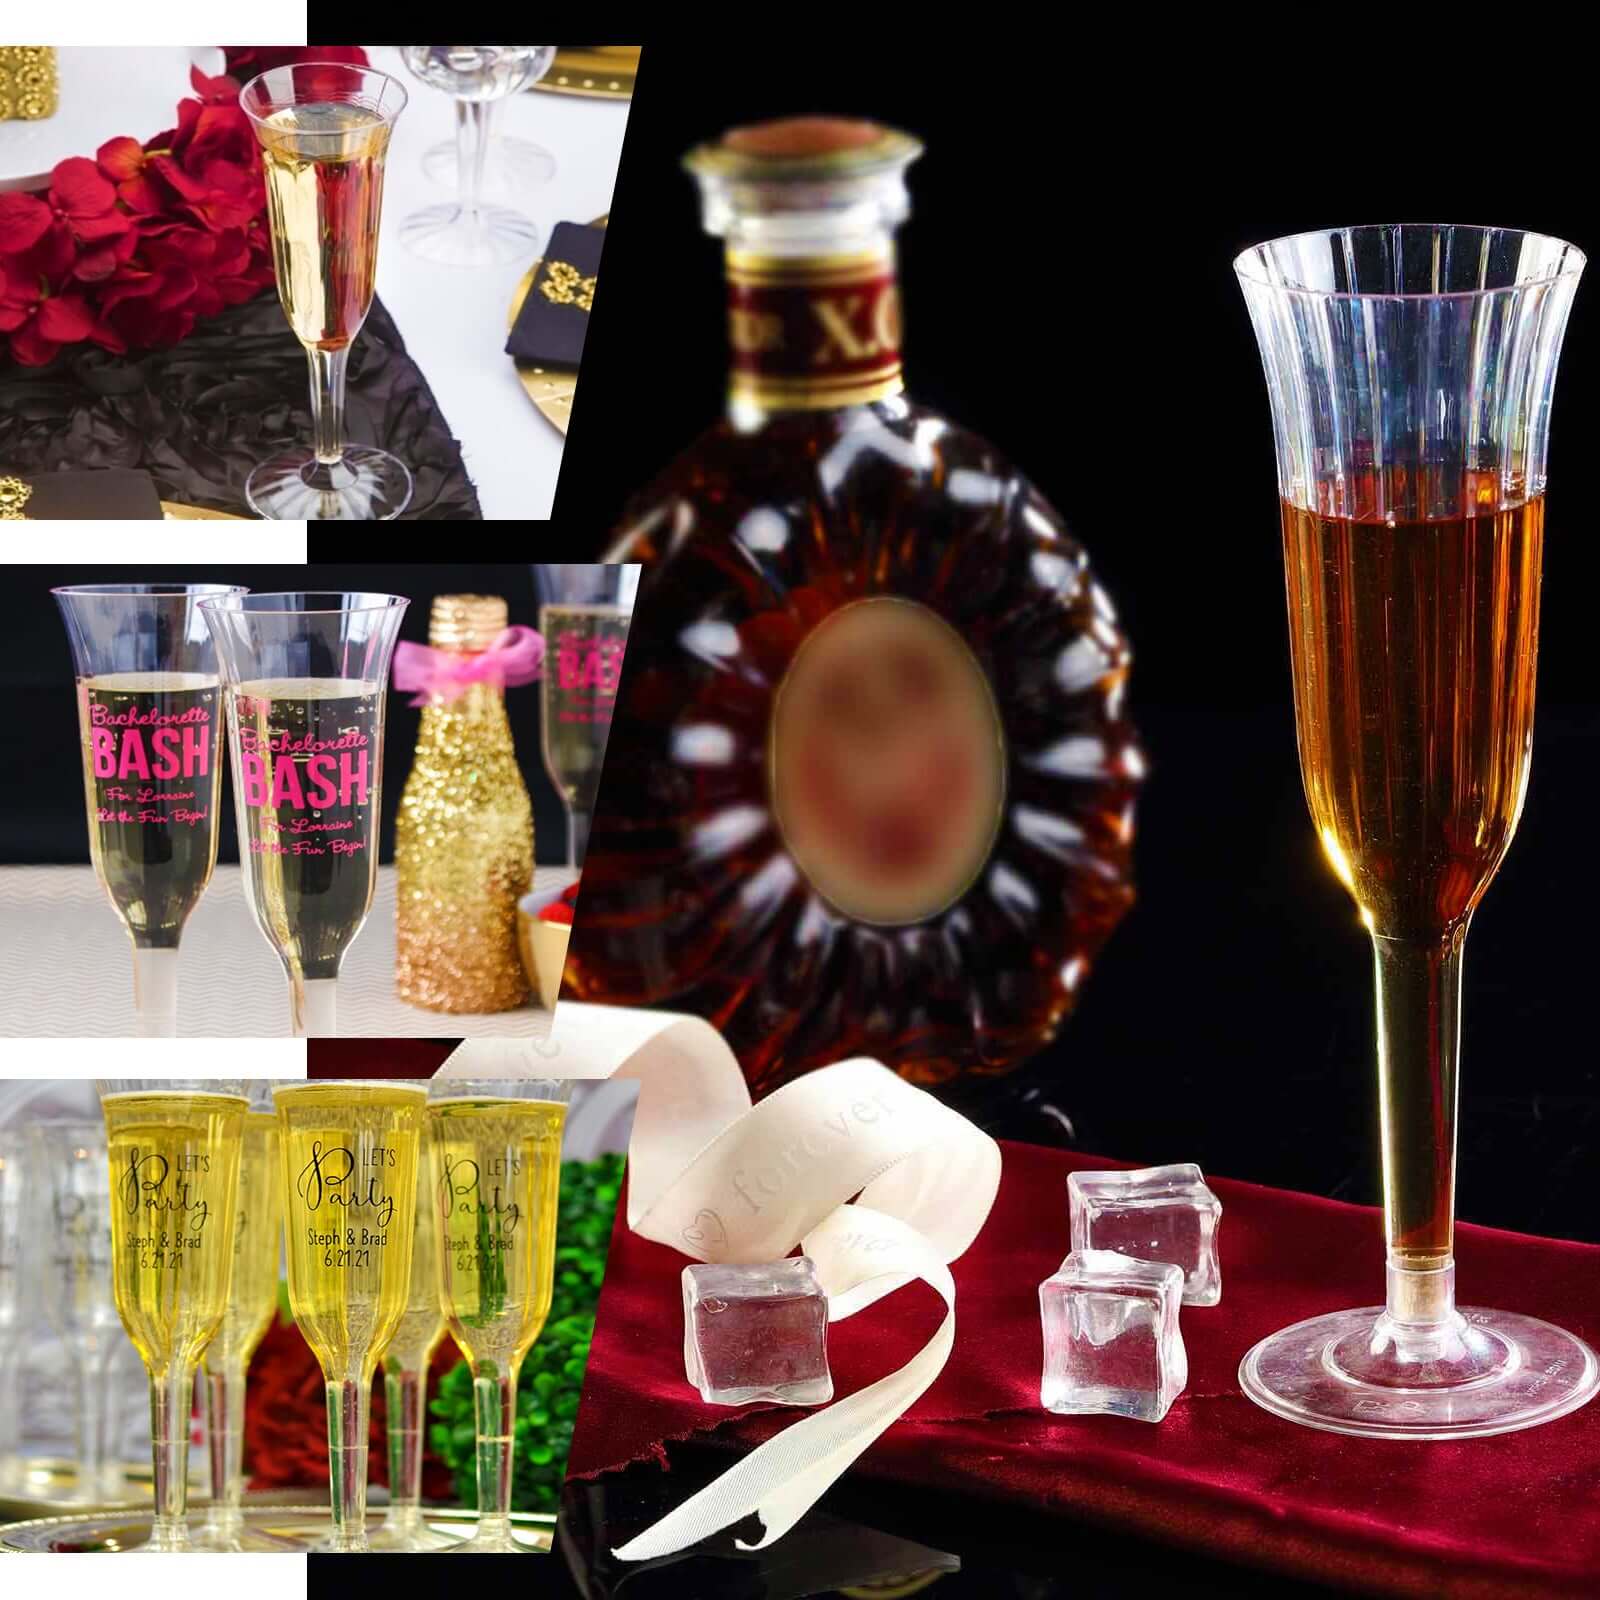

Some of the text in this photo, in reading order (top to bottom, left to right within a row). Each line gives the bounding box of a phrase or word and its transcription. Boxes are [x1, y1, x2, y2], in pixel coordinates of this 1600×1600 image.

[90, 704, 210, 726] Bachelorette
[240, 727, 368, 752] Bachelorette
[92, 725, 209, 780] BASH
[242, 750, 368, 809] BASH
[104, 787, 195, 803] For Lorraine
[137, 809, 169, 823] Fun
[290, 818, 353, 833] Lorraine
[291, 841, 324, 855] Fun
[177, 1154, 210, 1172] LET'S
[362, 1148, 396, 1167] LET'S
[487, 1159, 520, 1176] LET'S
[119, 1148, 212, 1231] Party
[297, 1140, 398, 1228] Party
[127, 1232, 202, 1251] Steph & Brad
[308, 1228, 388, 1249] Steph & Brad
[141, 1252, 183, 1269] 6.21.21
[324, 1250, 370, 1267] 6.21.21
